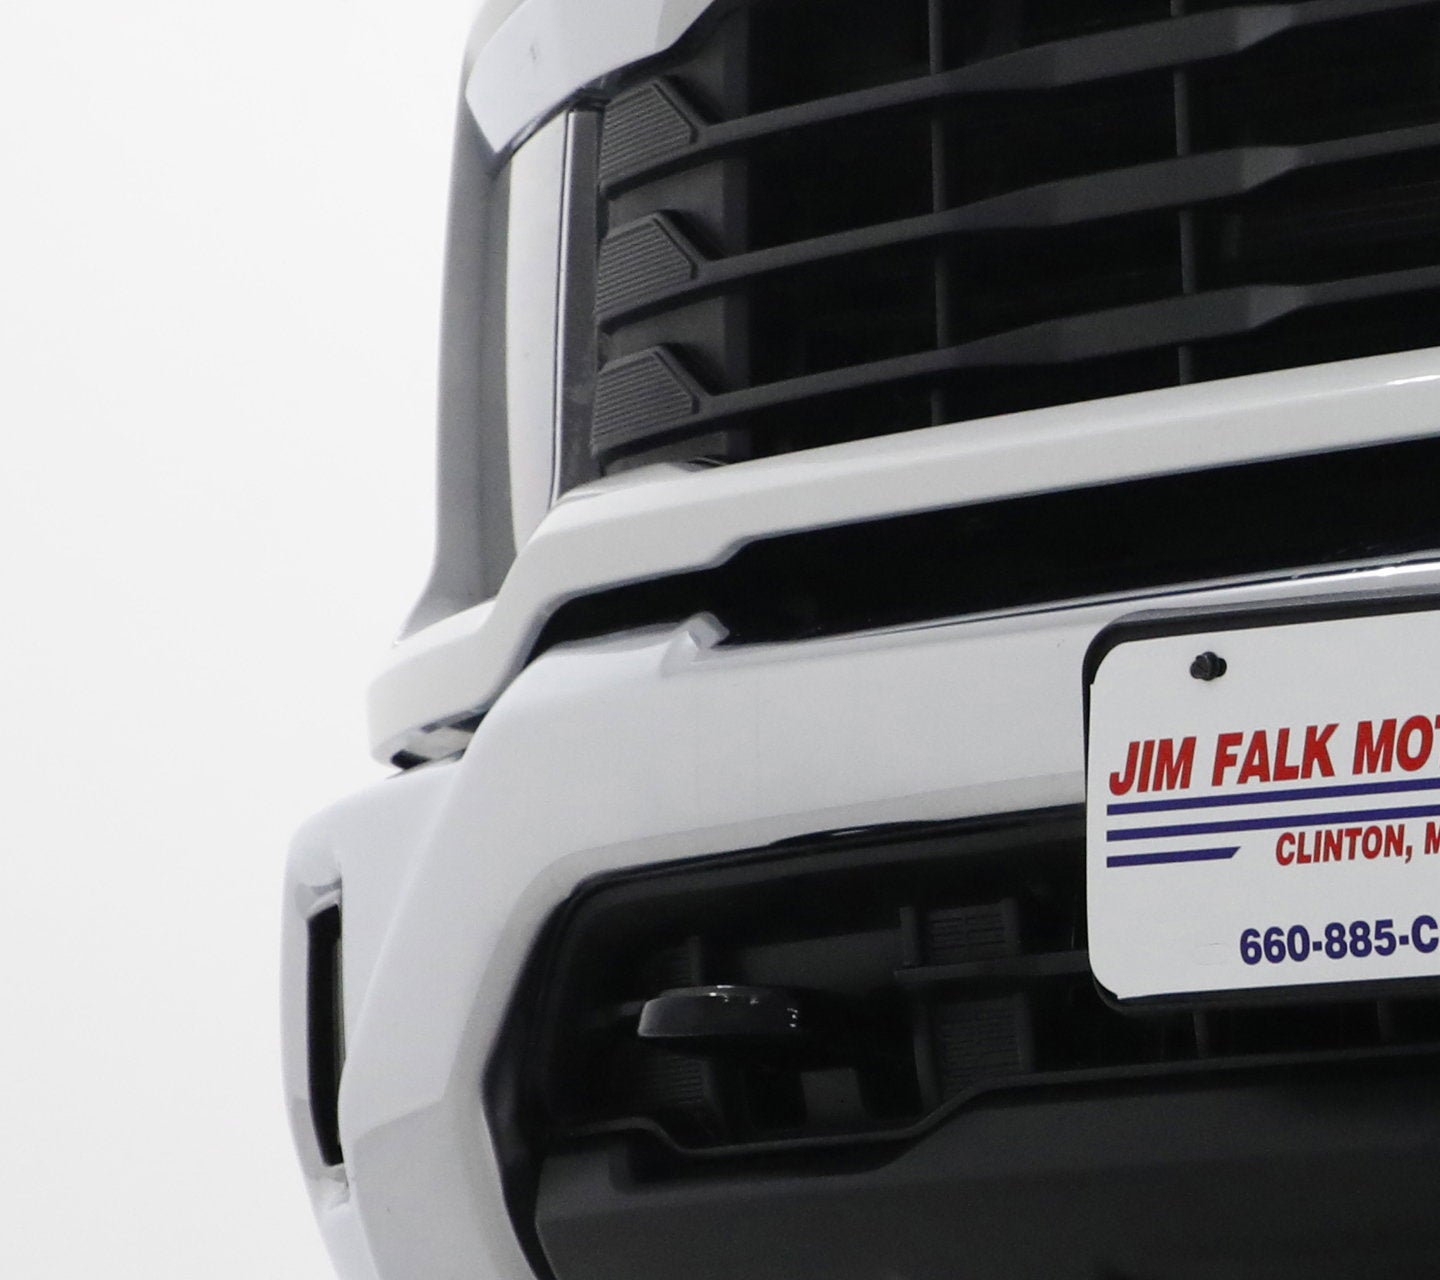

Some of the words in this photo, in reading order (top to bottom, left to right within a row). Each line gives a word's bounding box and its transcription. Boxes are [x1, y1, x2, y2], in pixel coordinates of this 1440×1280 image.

[1108, 736, 1197, 796] JIM
[1211, 723, 1339, 786] FALK
[1275, 824, 1413, 866] CLINTON,
